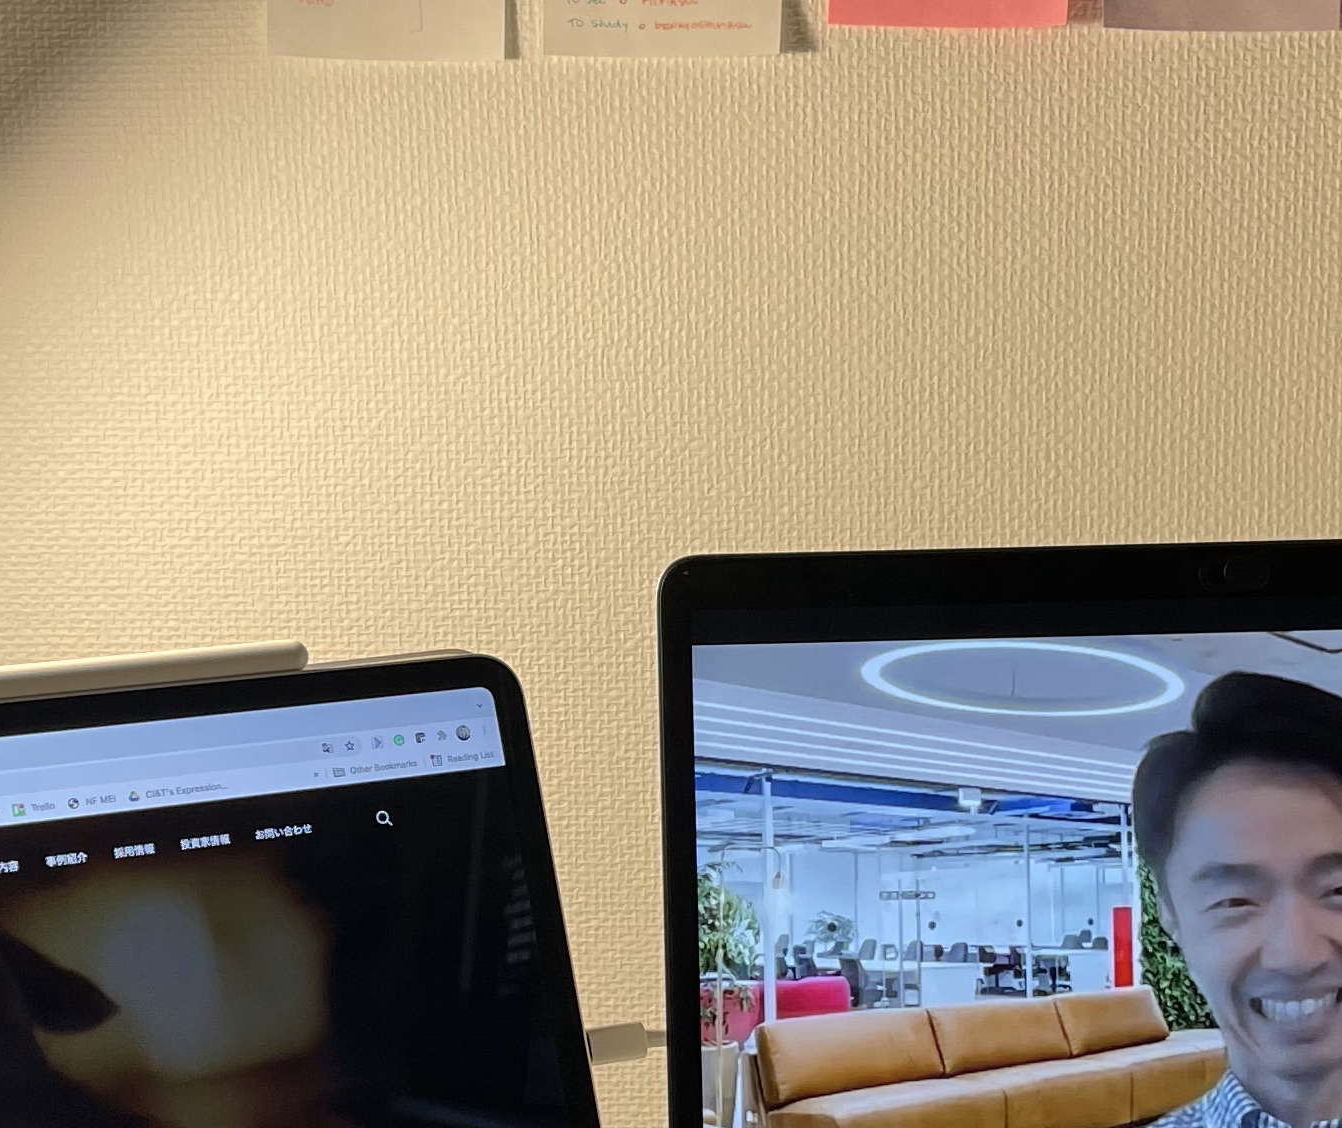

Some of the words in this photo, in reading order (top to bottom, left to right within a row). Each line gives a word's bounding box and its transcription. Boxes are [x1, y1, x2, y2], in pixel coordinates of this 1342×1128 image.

[447, 752, 479, 765] Reading
[480, 750, 494, 759] List
[350, 764, 373, 775] Other
[374, 759, 418, 772] Bookmarks
[31, 802, 56, 812] Trello
[255, 823, 313, 841] お問い合わせ
[179, 833, 231, 850] 投資家情報
[113, 842, 156, 859] 採用情報
[45, 851, 89, 868] 事例紹介
